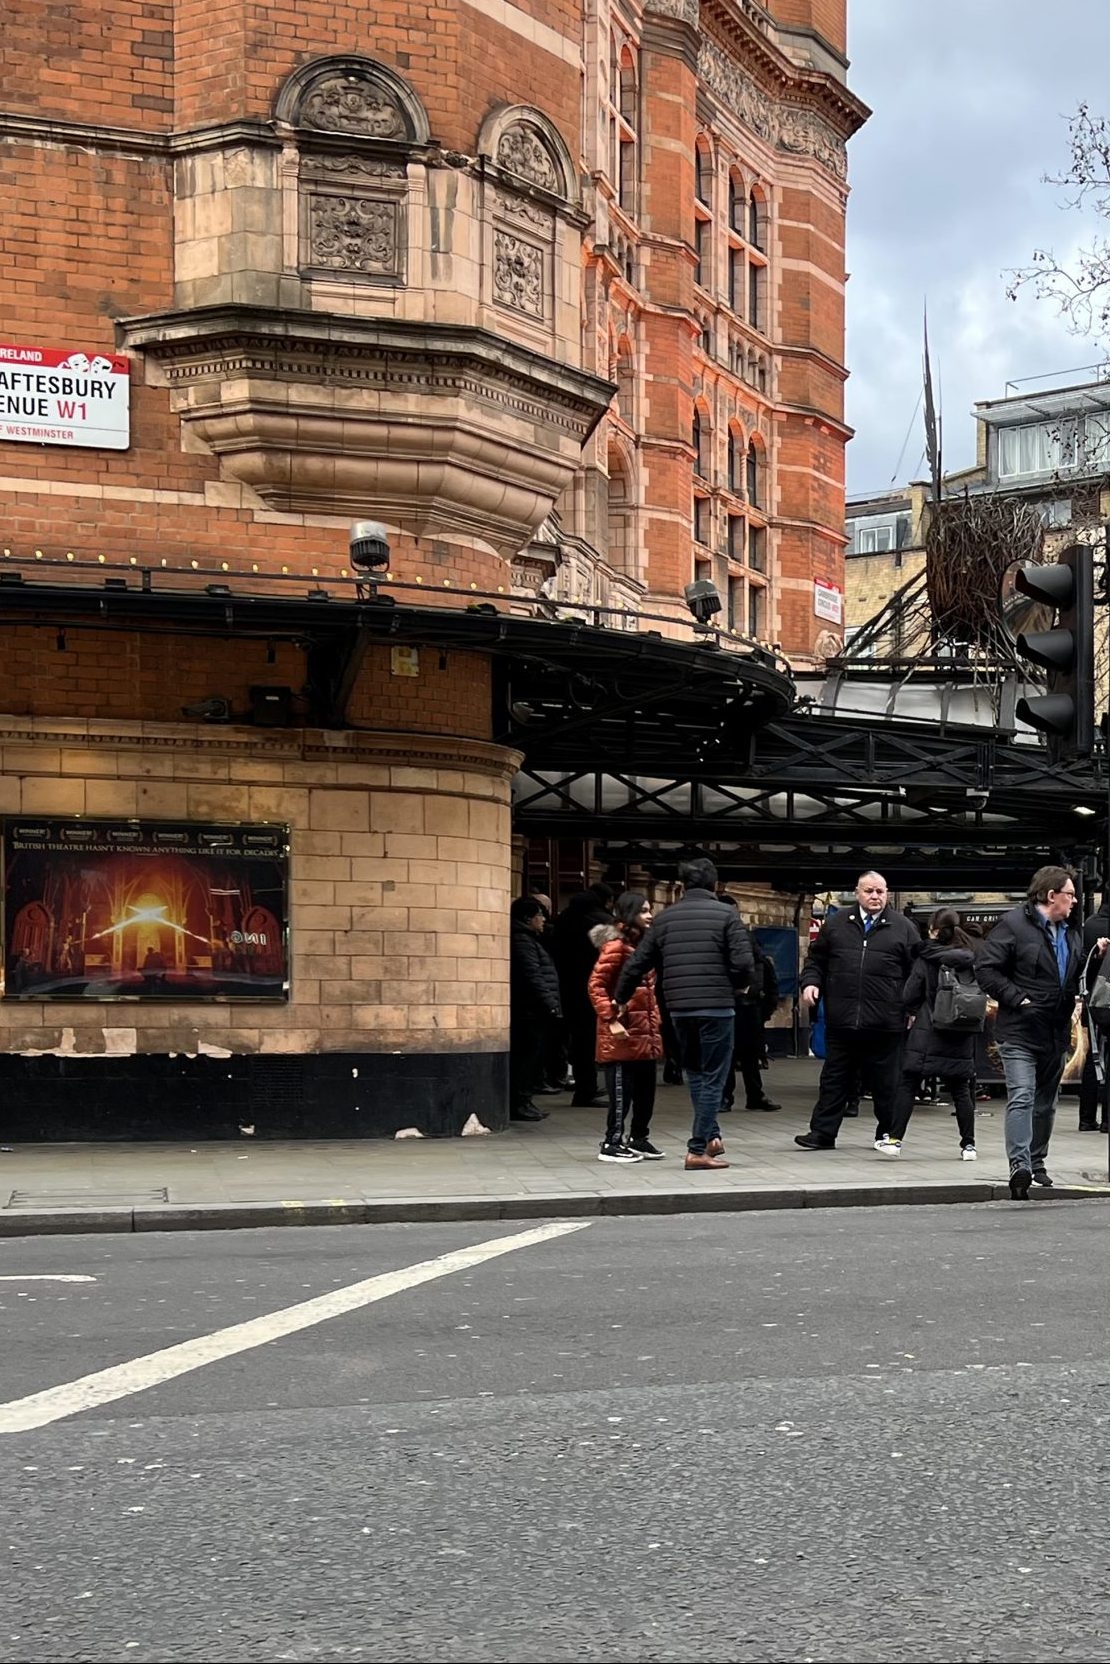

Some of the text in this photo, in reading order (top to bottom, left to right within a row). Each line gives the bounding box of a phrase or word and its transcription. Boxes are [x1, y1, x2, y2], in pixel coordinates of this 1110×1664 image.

[0, 371, 116, 399] AFTESBURY
[57, 400, 87, 420] W1
[6, 426, 74, 440] WESTMINSTER
